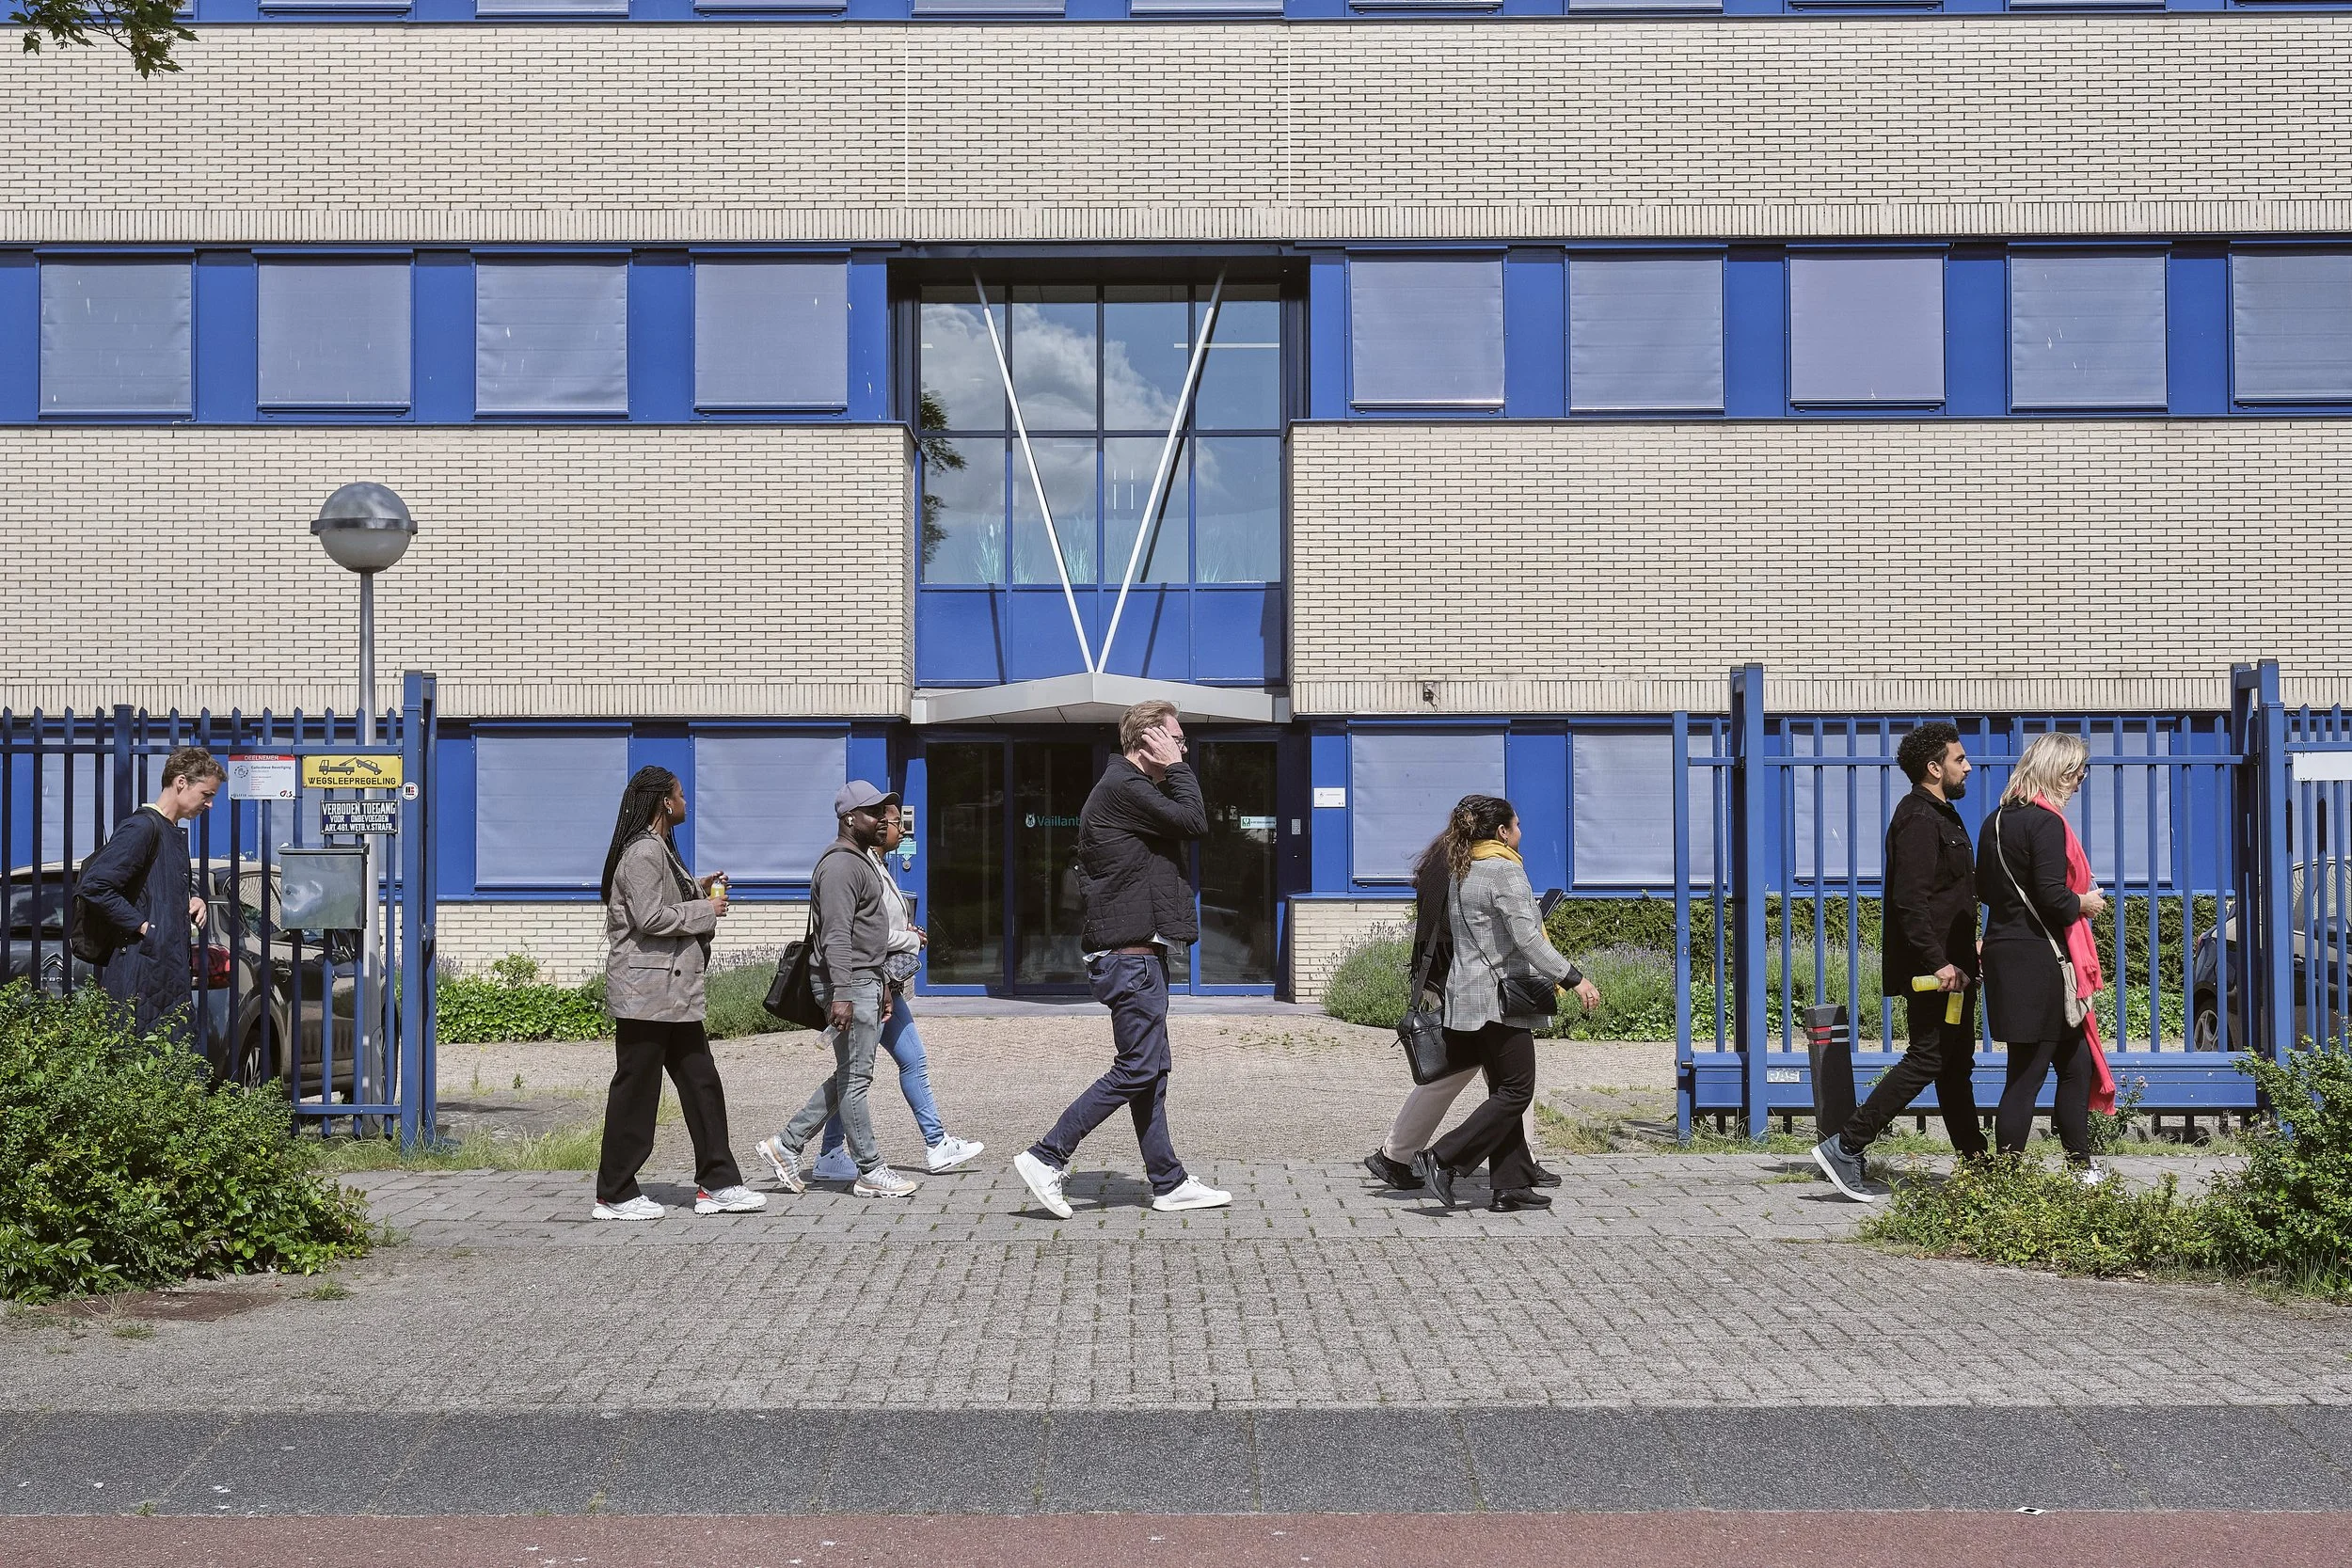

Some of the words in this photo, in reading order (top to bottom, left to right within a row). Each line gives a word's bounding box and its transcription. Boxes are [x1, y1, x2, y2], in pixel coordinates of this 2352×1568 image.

[308, 777, 396, 785] WEGSLEEPREGELING
[322, 803, 360, 816] VERBODEN
[362, 802, 396, 815] TOEGANG
[1037, 816, 1082, 827] Vaillant
